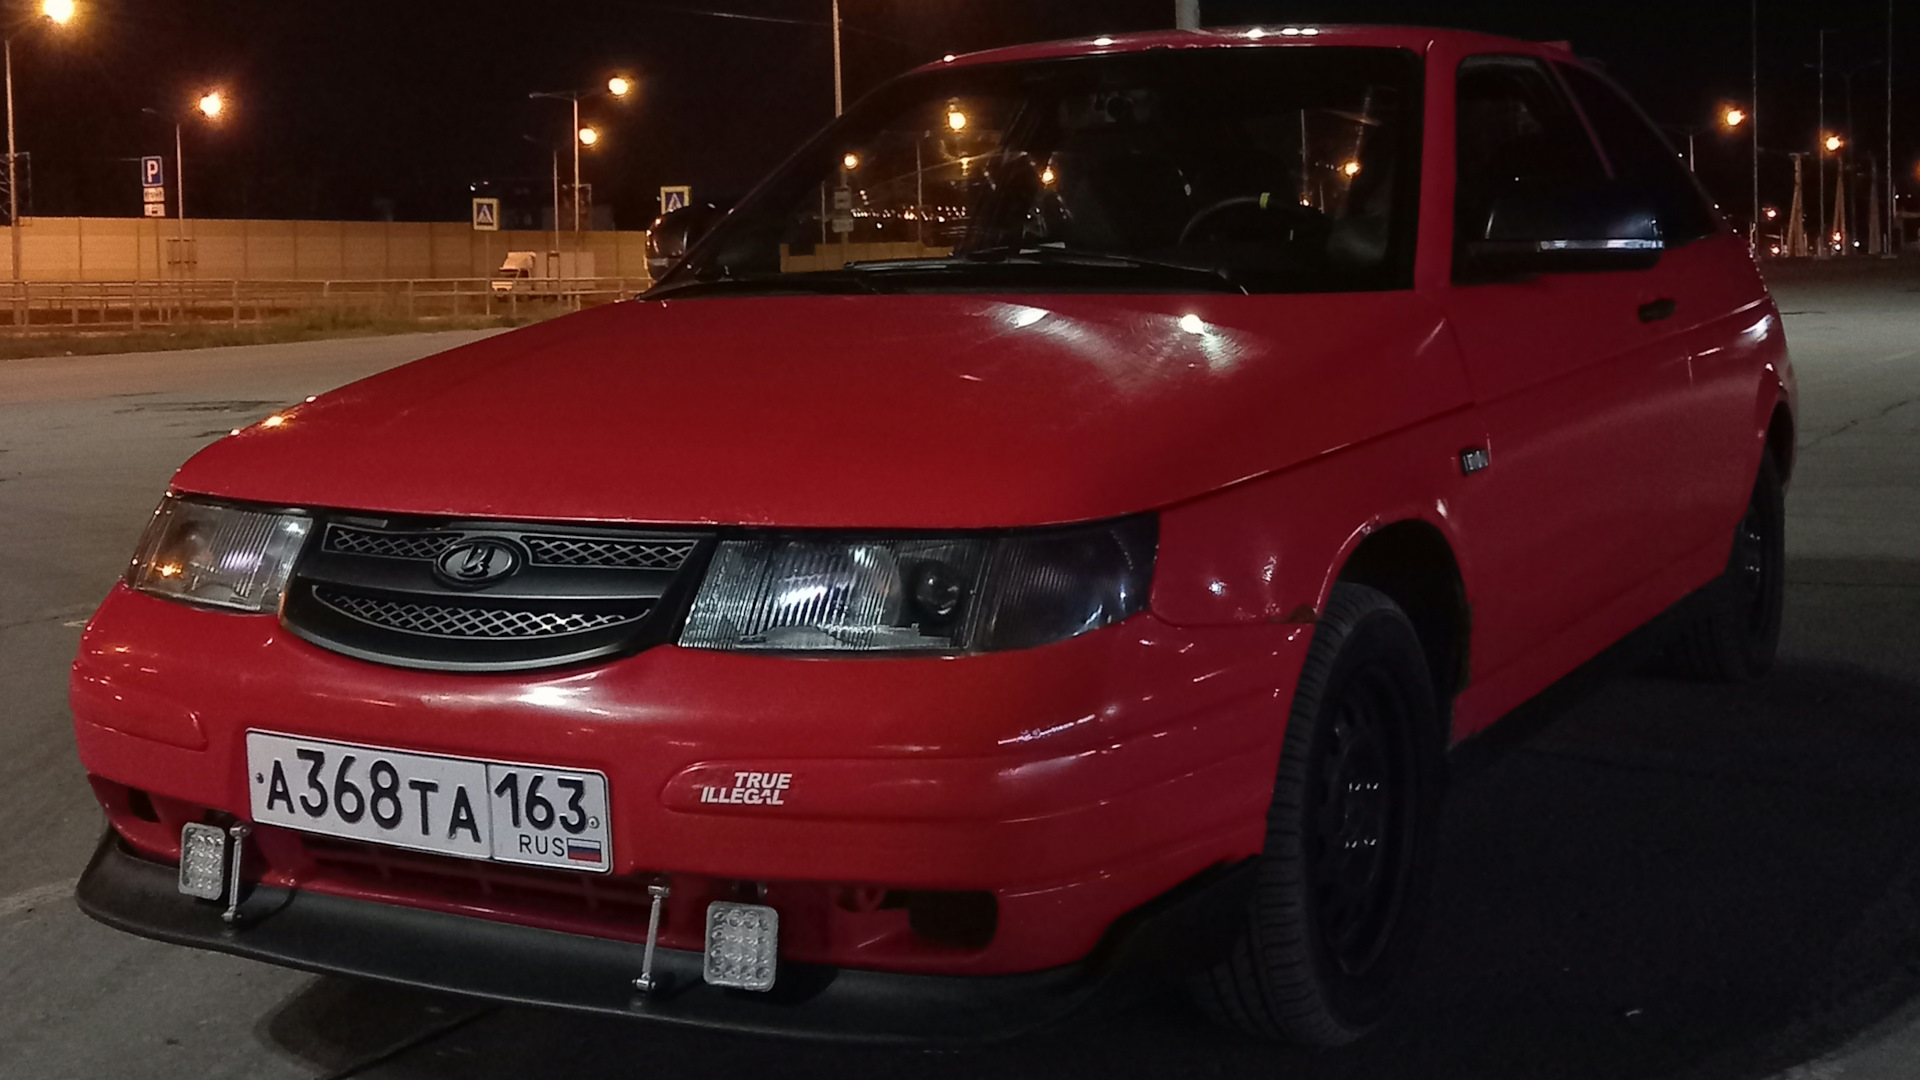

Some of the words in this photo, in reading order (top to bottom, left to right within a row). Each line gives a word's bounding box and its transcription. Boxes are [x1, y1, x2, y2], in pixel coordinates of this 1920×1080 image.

[146, 160, 159, 183] P
[734, 772, 792, 788] TRUE
[494, 773, 588, 834] 163
[700, 788, 784, 805] ILLEGAL
[518, 834, 566, 857] RUS
